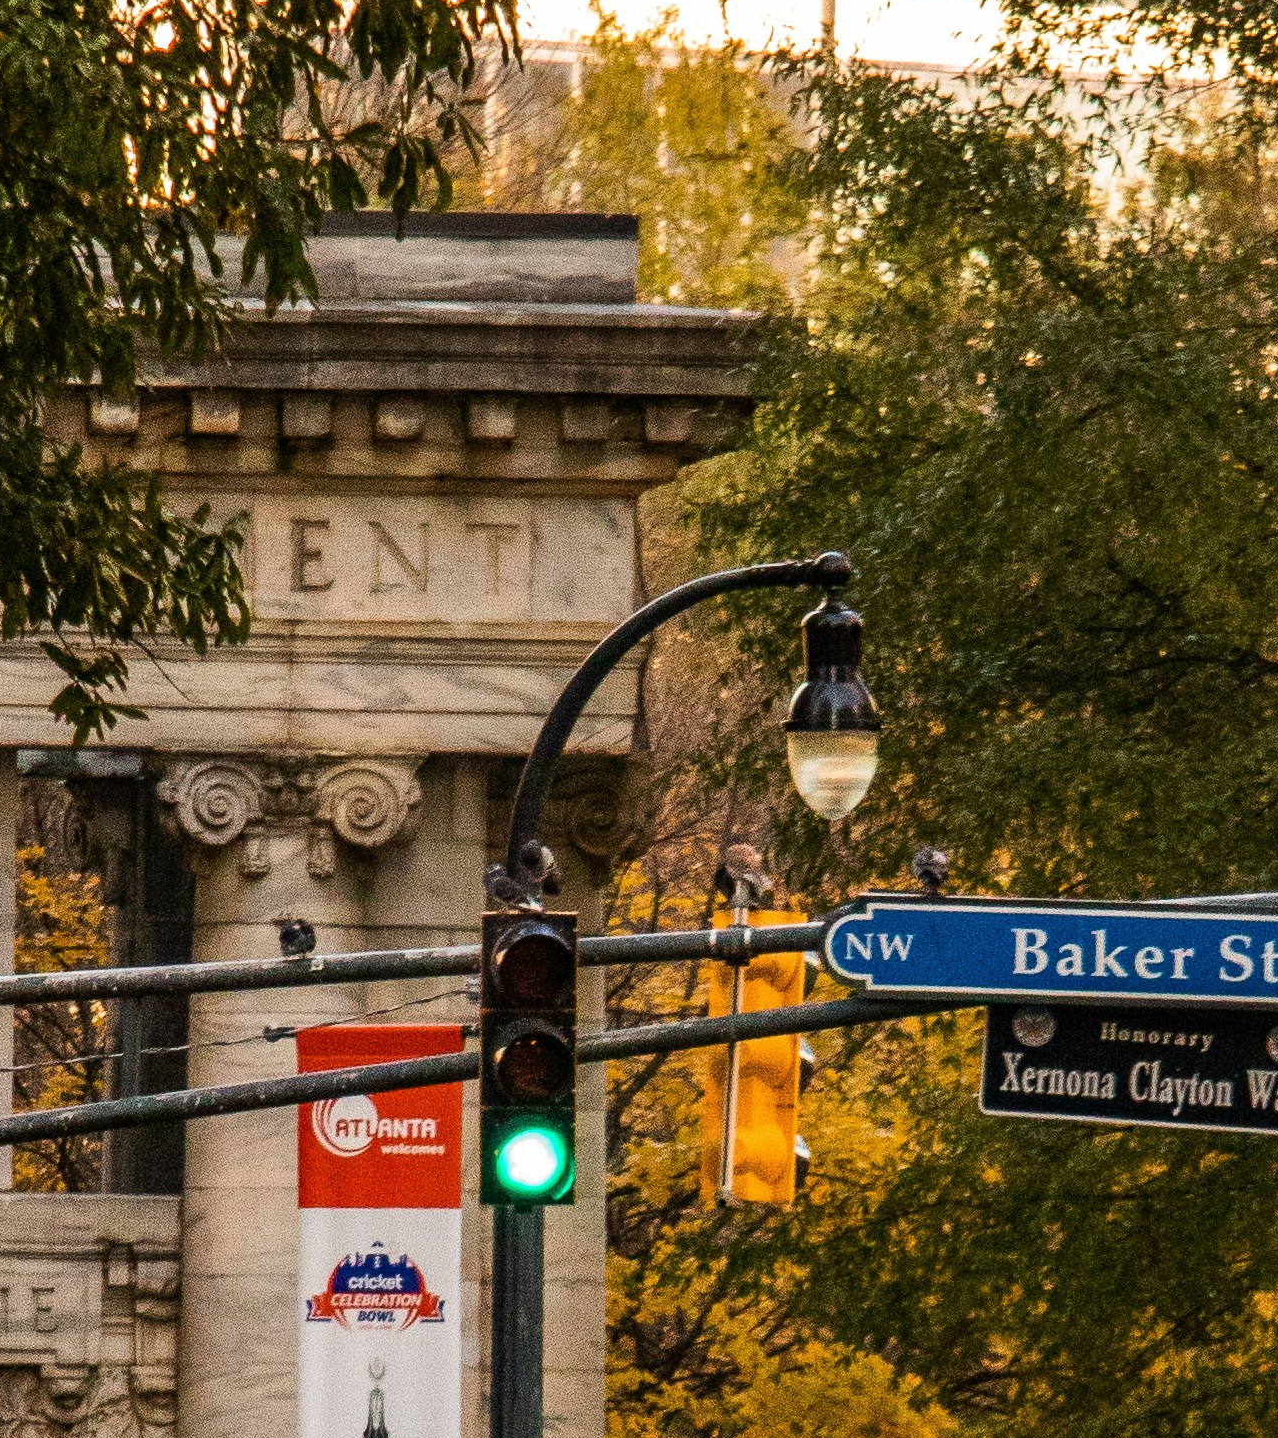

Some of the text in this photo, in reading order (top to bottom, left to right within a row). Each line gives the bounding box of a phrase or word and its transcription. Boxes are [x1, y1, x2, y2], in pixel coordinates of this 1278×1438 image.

[844, 930, 914, 963] NW
[1012, 927, 1194, 981] Baker
[1100, 1021, 1213, 1051] Honorary
[998, 1051, 1115, 1100] Xernona
[1128, 1060, 1233, 1116] Clayton
[335, 1118, 437, 1138] ATLANTA
[380, 1144, 444, 1155] welcomes
[348, 1274, 402, 1290] cricket
[331, 1293, 422, 1307] CELEBRATION
[357, 1310, 395, 1322] BOWL
